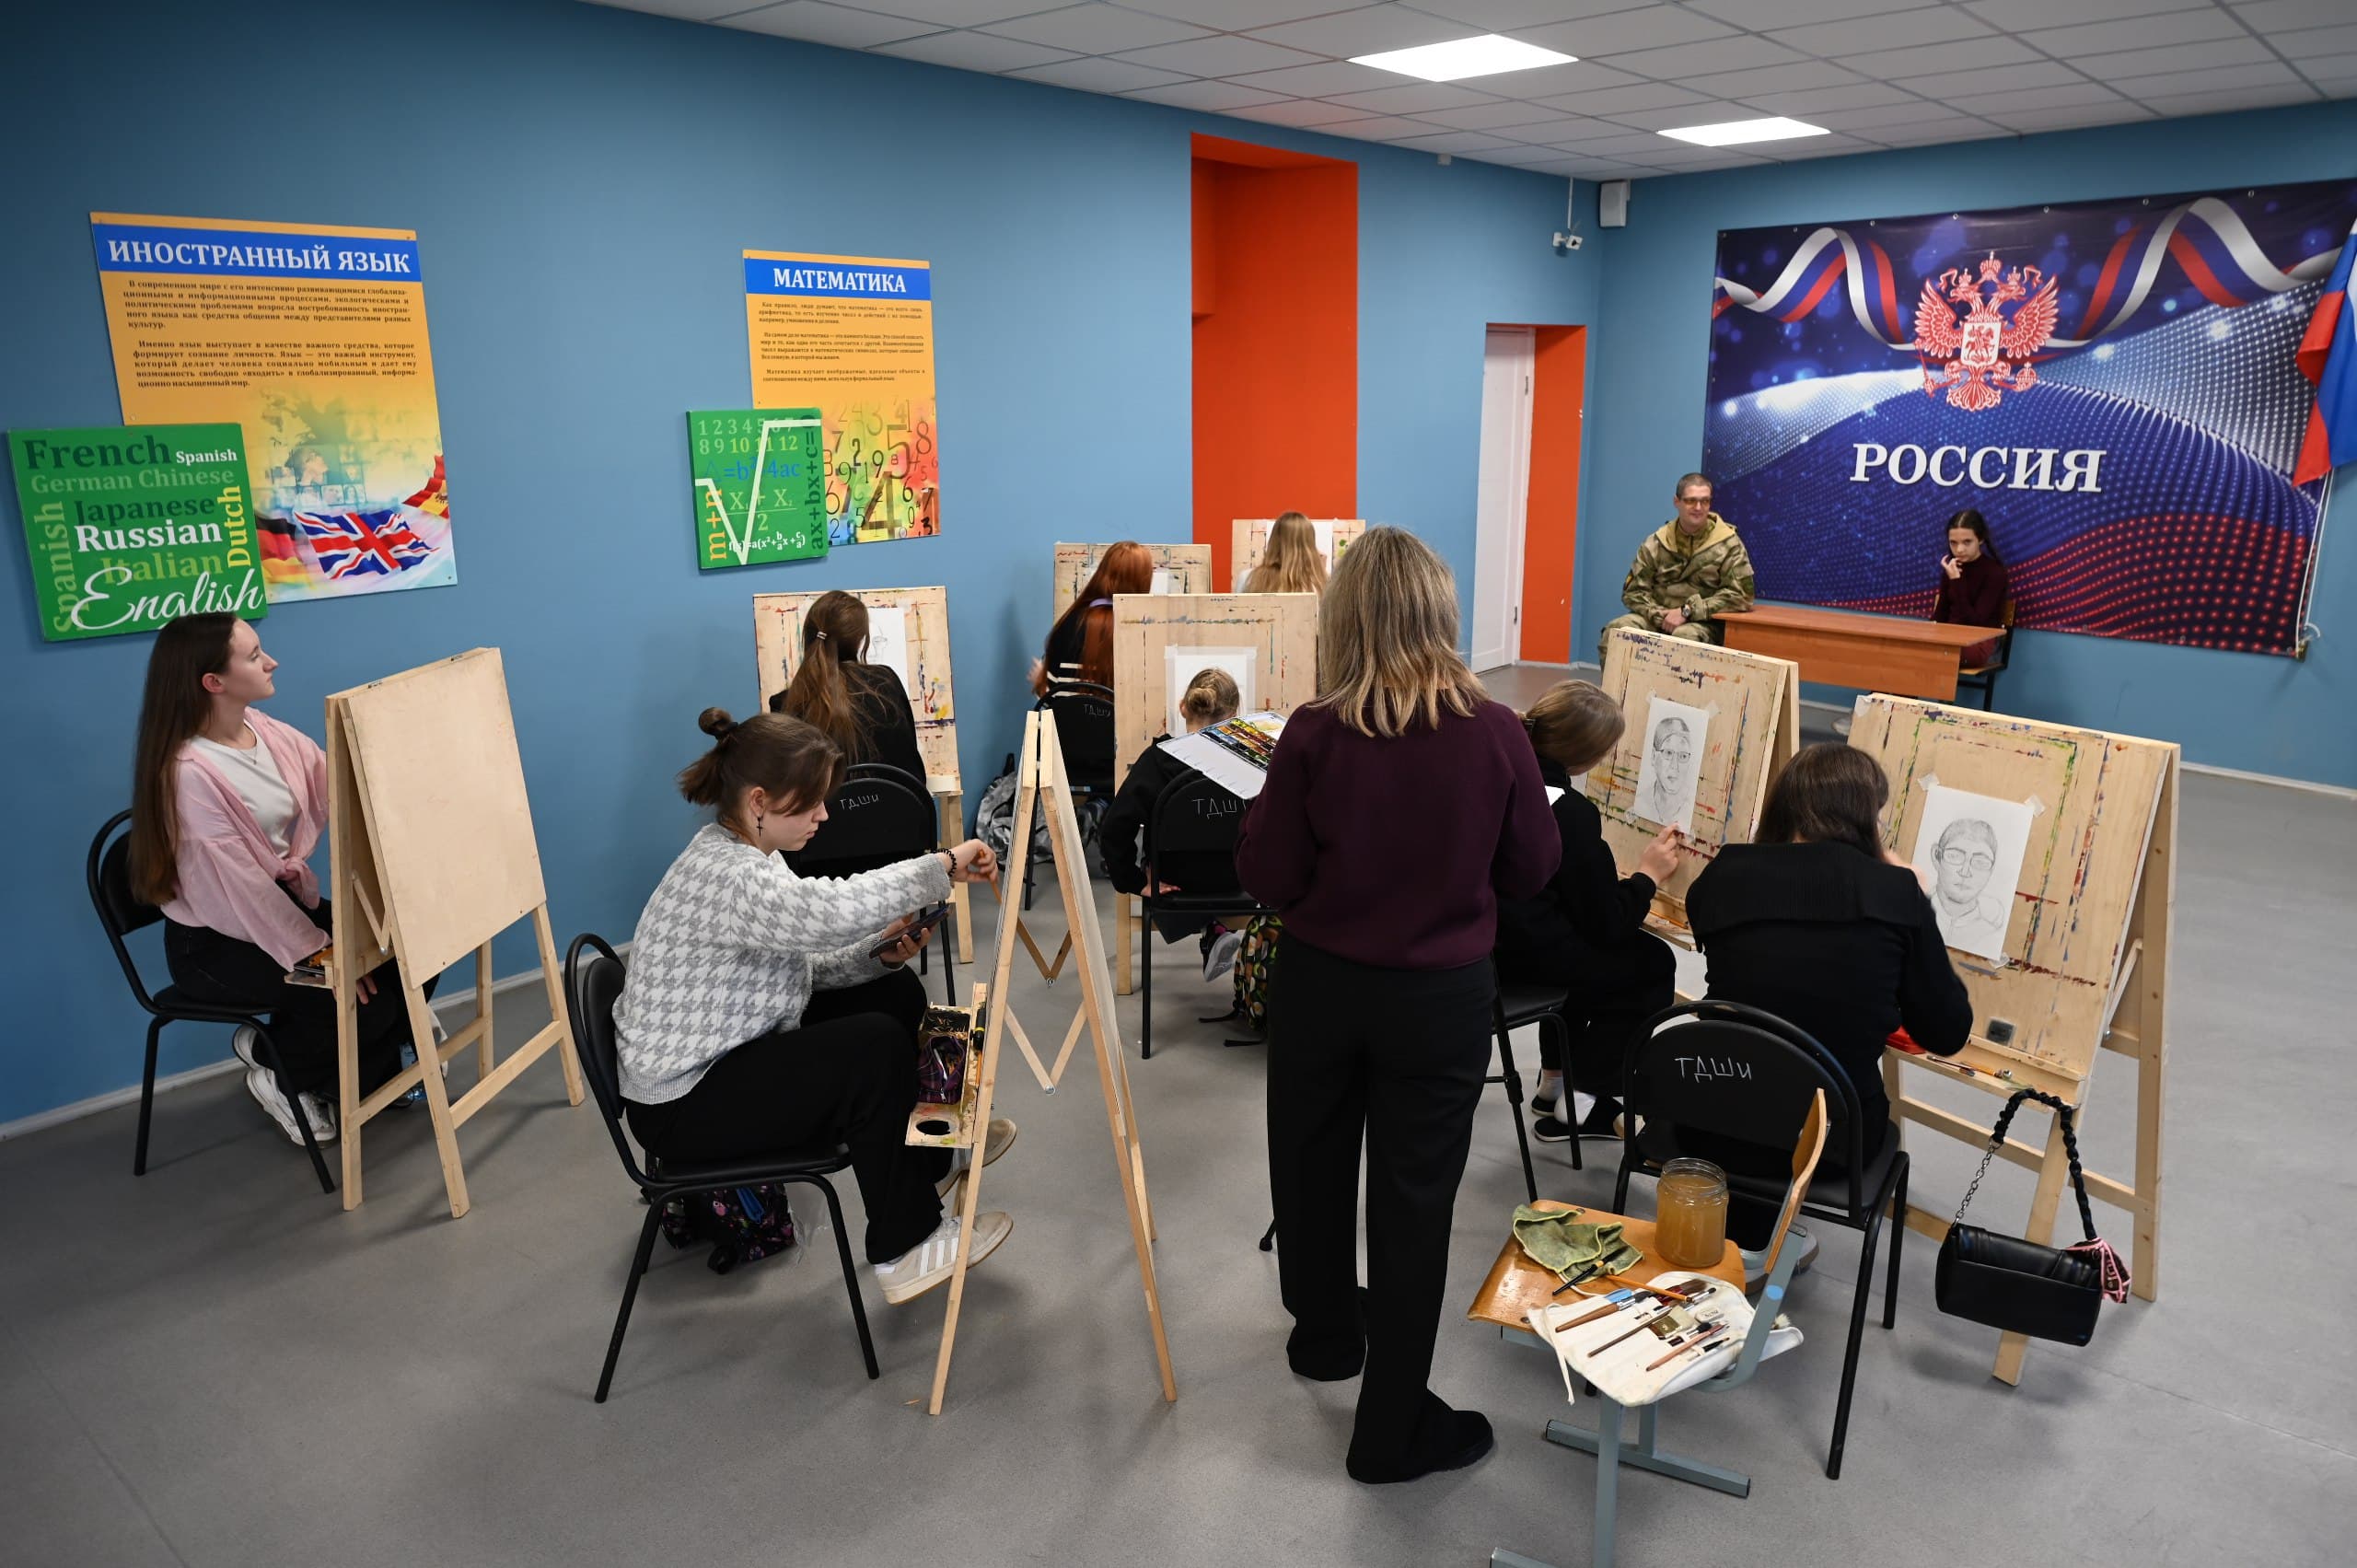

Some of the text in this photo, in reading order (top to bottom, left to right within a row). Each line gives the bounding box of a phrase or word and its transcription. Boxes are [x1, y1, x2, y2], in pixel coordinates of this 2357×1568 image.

[108, 239, 412, 273] ИНОСТРАННЫЙ ЯЗЫК
[773, 268, 906, 293] МАТЕМАТИКА
[699, 420, 708, 436] 1
[713, 419, 723, 436] 2
[727, 418, 737, 435] 3
[742, 418, 753, 434] 4
[22, 436, 238, 470] French Spanish
[699, 438, 710, 455] 8
[714, 438, 725, 454] 9
[729, 437, 750, 454] 10
[779, 435, 799, 451] 12
[30, 468, 234, 494] German Chinese
[1850, 443, 2107, 493] РОССИЯ
[75, 497, 215, 527] Japanese
[216, 485, 251, 568] Dutch
[74, 519, 223, 552] Russian
[100, 552, 224, 585] Italian
[1675, 1055, 1752, 1083] ТДШИ
